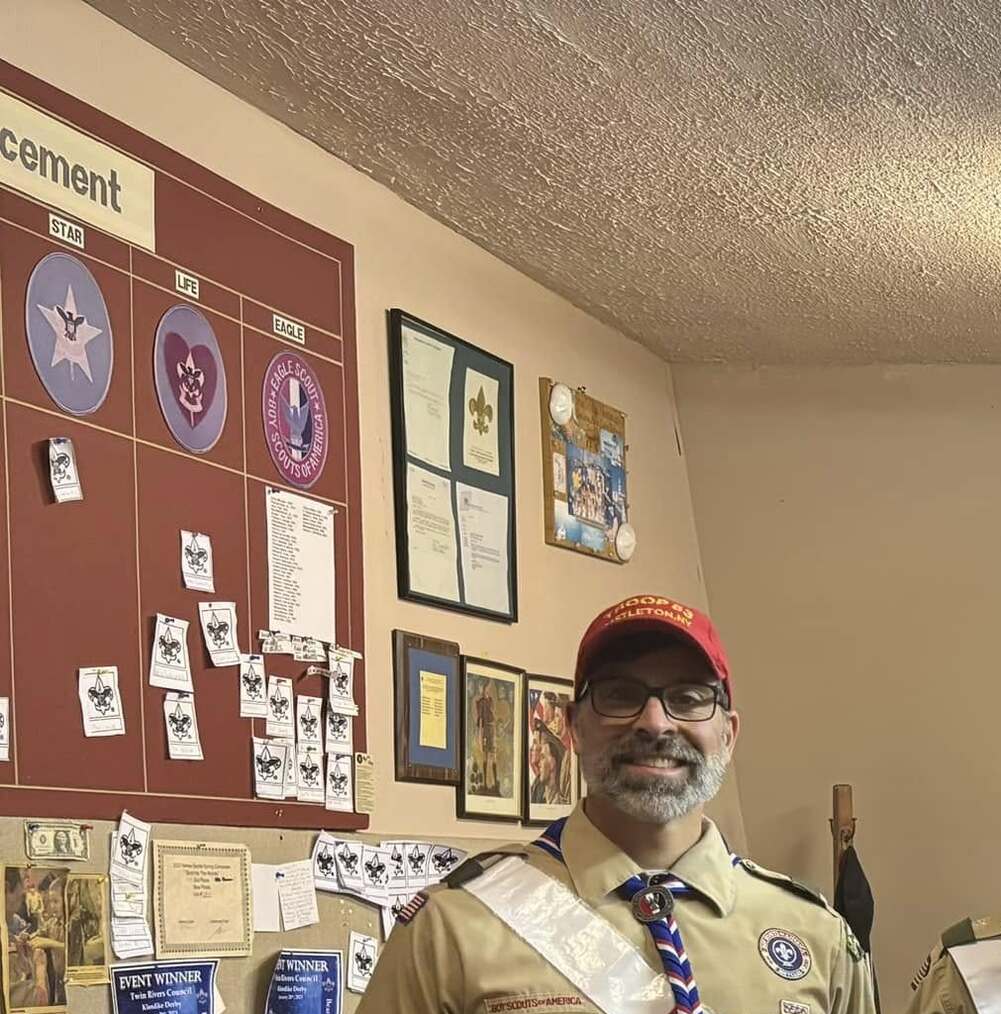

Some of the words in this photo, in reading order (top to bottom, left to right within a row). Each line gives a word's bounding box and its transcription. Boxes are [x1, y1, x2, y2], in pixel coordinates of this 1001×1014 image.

[0, 127, 122, 214] cement
[51, 218, 82, 245] STAR
[177, 274, 198, 295] LIFE
[275, 318, 304, 341] EAGLE
[270, 360, 294, 392] EAGLE
[294, 362, 319, 400] SCOUT
[267, 400, 279, 429] BOY
[271, 431, 301, 478] SCOUTS
[310, 414, 324, 472] AMERICA
[301, 461, 313, 478] OF
[286, 959, 329, 972] WINNER
[119, 973, 153, 990] EVENT
[154, 970, 202, 986] WINNER
[166, 987, 193, 997] Council
[507, 998, 538, 1011] SCOUTS
[546, 996, 582, 1006] AMERICA
